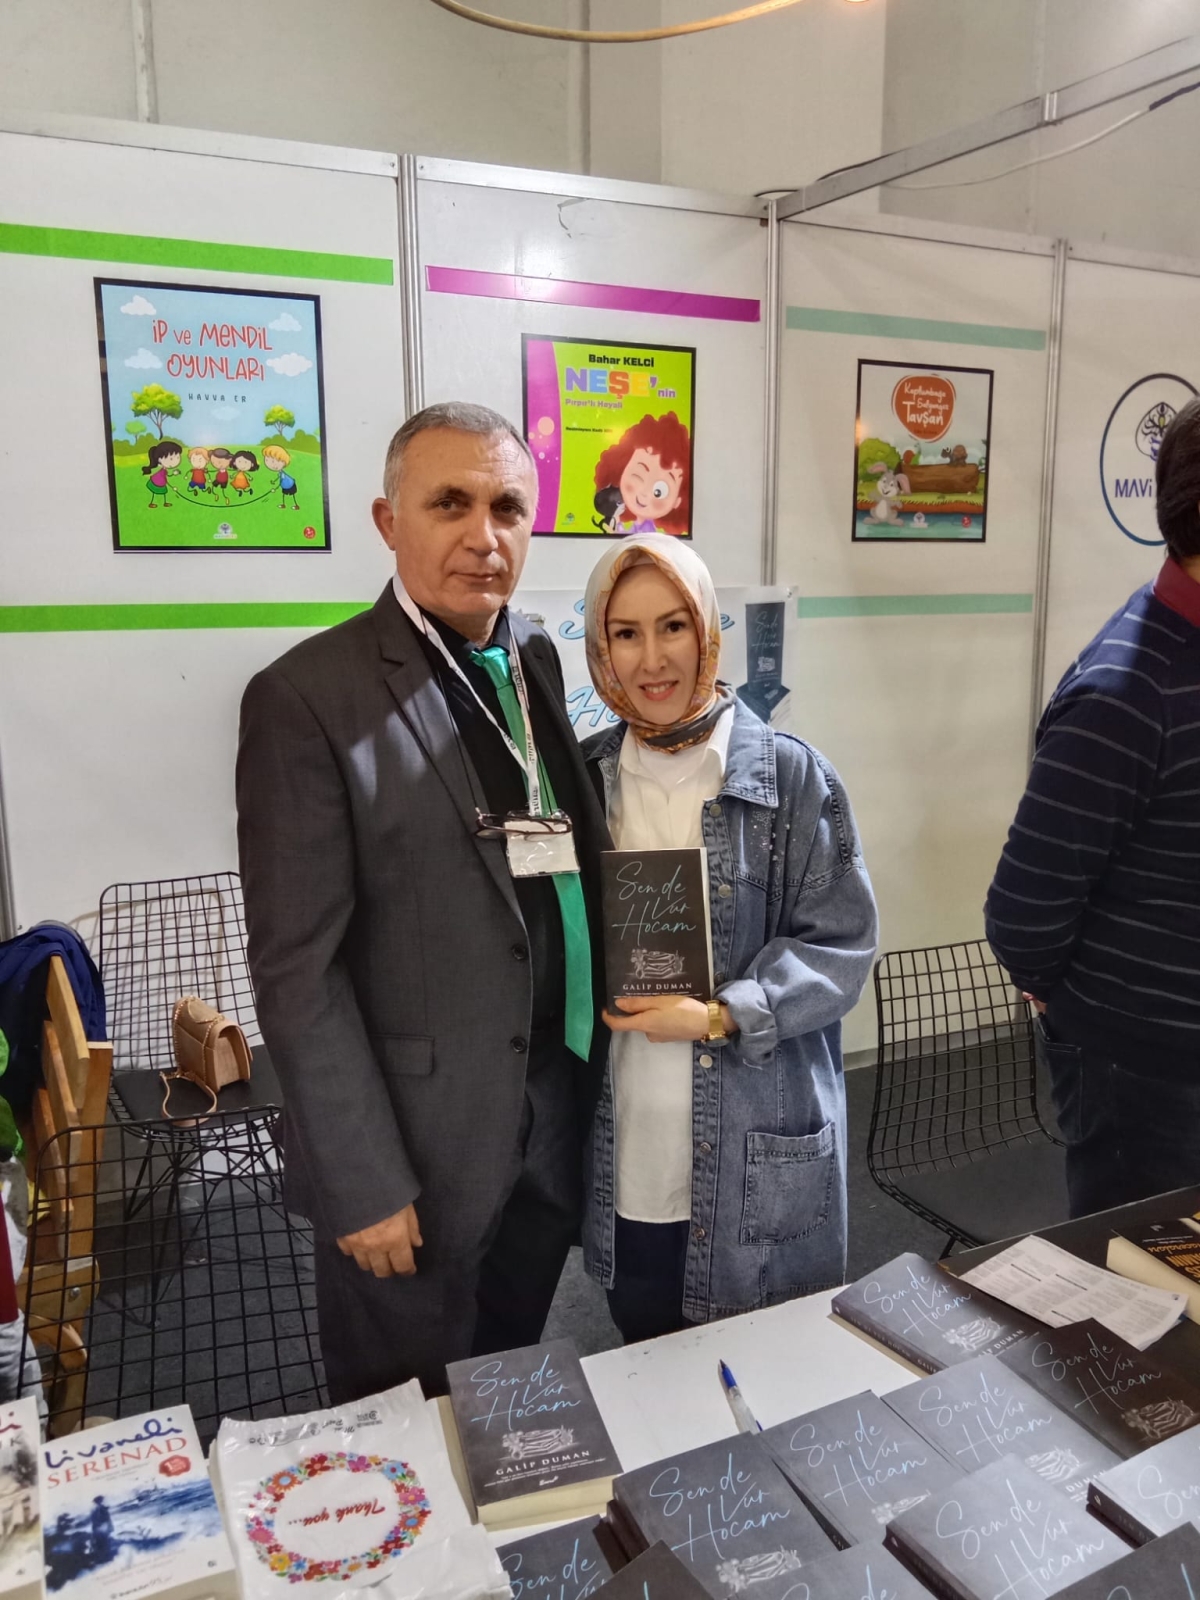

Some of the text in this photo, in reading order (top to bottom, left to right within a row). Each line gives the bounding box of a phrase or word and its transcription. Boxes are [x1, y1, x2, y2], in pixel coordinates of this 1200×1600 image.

[173, 330, 192, 345] ve
[166, 353, 265, 382] OYUNLARI
[588, 354, 654, 367] Bahar KELCİ
[188, 393, 247, 403] HAVVA ER
[902, 401, 944, 428] Tavşan
[616, 861, 686, 900] Sen de
[611, 901, 696, 946] Hocam
[656, 982, 692, 990] DUMAN
[863, 1281, 910, 1313] Sen
[907, 1265, 931, 1292] de
[903, 1293, 971, 1336] Hocam
[993, 1329, 1025, 1349] DUMAN
[1031, 1332, 1114, 1381] Sen de
[471, 1354, 560, 1397] Sen de
[1074, 1368, 1162, 1415] Hocam
[470, 1391, 581, 1431] Hocam
[919, 1372, 1006, 1427] Sen de
[542, 1450, 591, 1466] DUMAN
[790, 1410, 882, 1468] Sen de
[956, 1414, 1053, 1463] Hocam
[47, 1437, 188, 1489] SERENAD
[649, 1453, 751, 1517] Sen de
[823, 1454, 927, 1507] Hocam
[335, 1498, 386, 1524] Thank
[671, 1504, 791, 1562] Hocam
[935, 1478, 1041, 1559] Sen de
[562, 1538, 596, 1584] de
